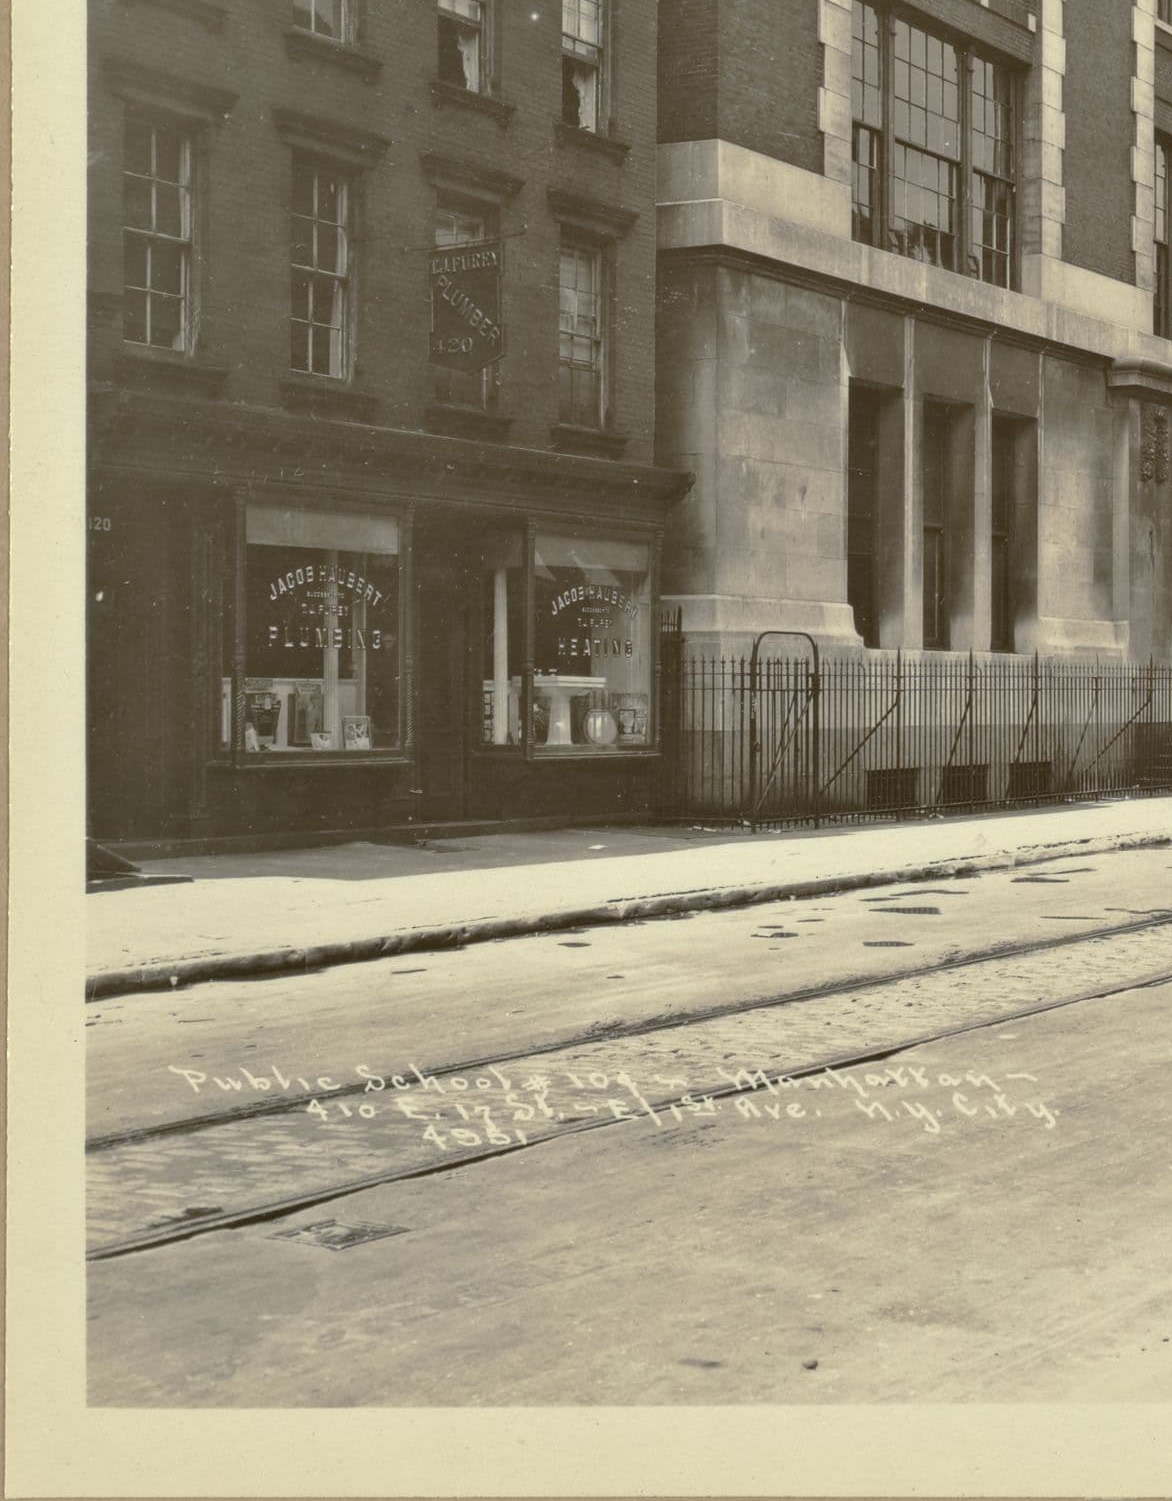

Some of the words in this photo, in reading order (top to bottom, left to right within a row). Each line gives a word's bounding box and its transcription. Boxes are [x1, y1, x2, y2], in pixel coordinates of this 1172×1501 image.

[438, 274, 501, 348] PLUMBER
[269, 565, 315, 601] JACOB
[319, 564, 382, 606] HAUBERT
[552, 585, 585, 616] JACOB
[268, 626, 382, 650] PLUMBING
[558, 636, 633, 658] HEATING
